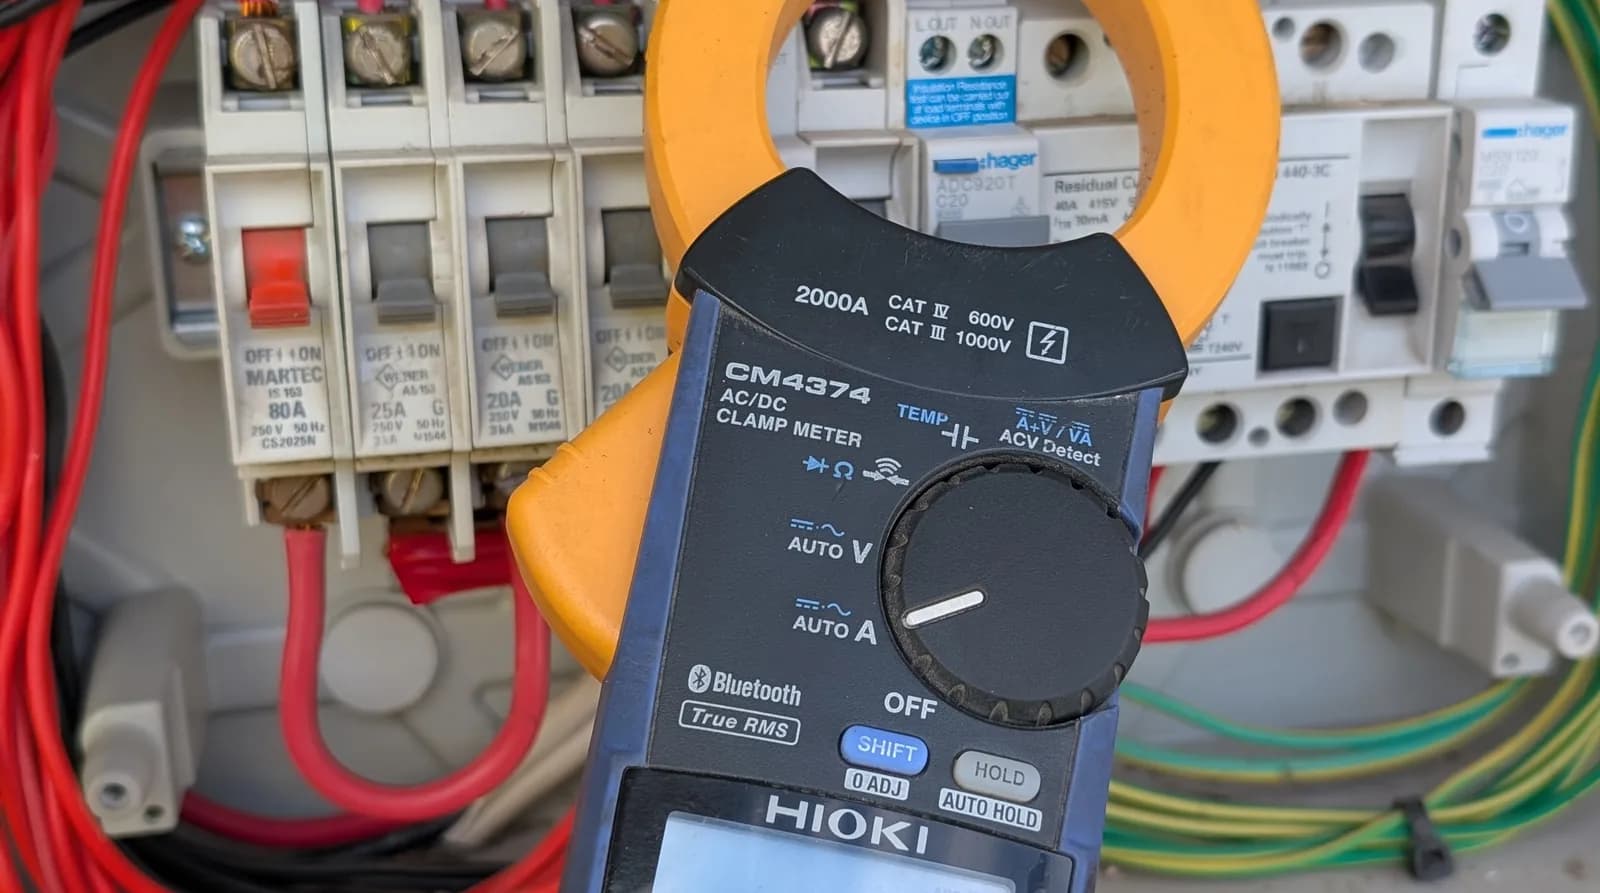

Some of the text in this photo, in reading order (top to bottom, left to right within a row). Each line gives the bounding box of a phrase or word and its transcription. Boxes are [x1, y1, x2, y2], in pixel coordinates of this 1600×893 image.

[927, 16, 958, 31] OUT
[984, 15, 1012, 29] OUT
[986, 152, 1037, 170] hager
[1054, 176, 1118, 194] Residual
[794, 284, 870, 317] 2000A
[887, 293, 928, 316] CAT
[968, 310, 1015, 333] 600V
[885, 315, 925, 337] CAT
[955, 330, 1012, 354] 1000V
[245, 346, 322, 364] OFF ON
[418, 343, 440, 359] ON
[245, 366, 324, 386] MARTEC
[724, 360, 871, 405] CM4374
[268, 400, 306, 420] 80A
[371, 399, 445, 420] 25A G
[487, 388, 559, 410] 20A G
[719, 388, 788, 413] AC/DC
[716, 408, 863, 448] CLAMP METER
[896, 403, 949, 426] TEMP
[999, 428, 1102, 468] ACV Detect
[787, 535, 874, 564] AUTO V
[792, 614, 878, 646] AUTO A
[712, 670, 802, 707] Bluetooth
[883, 690, 938, 720] OFF
[690, 706, 789, 739] True RMS
[857, 734, 918, 763] SHIFT
[866, 775, 902, 798] ADJ
[974, 760, 1025, 787] HOLD
[941, 790, 1038, 829] AUTO HOLD
[765, 794, 929, 855] HIOKI
